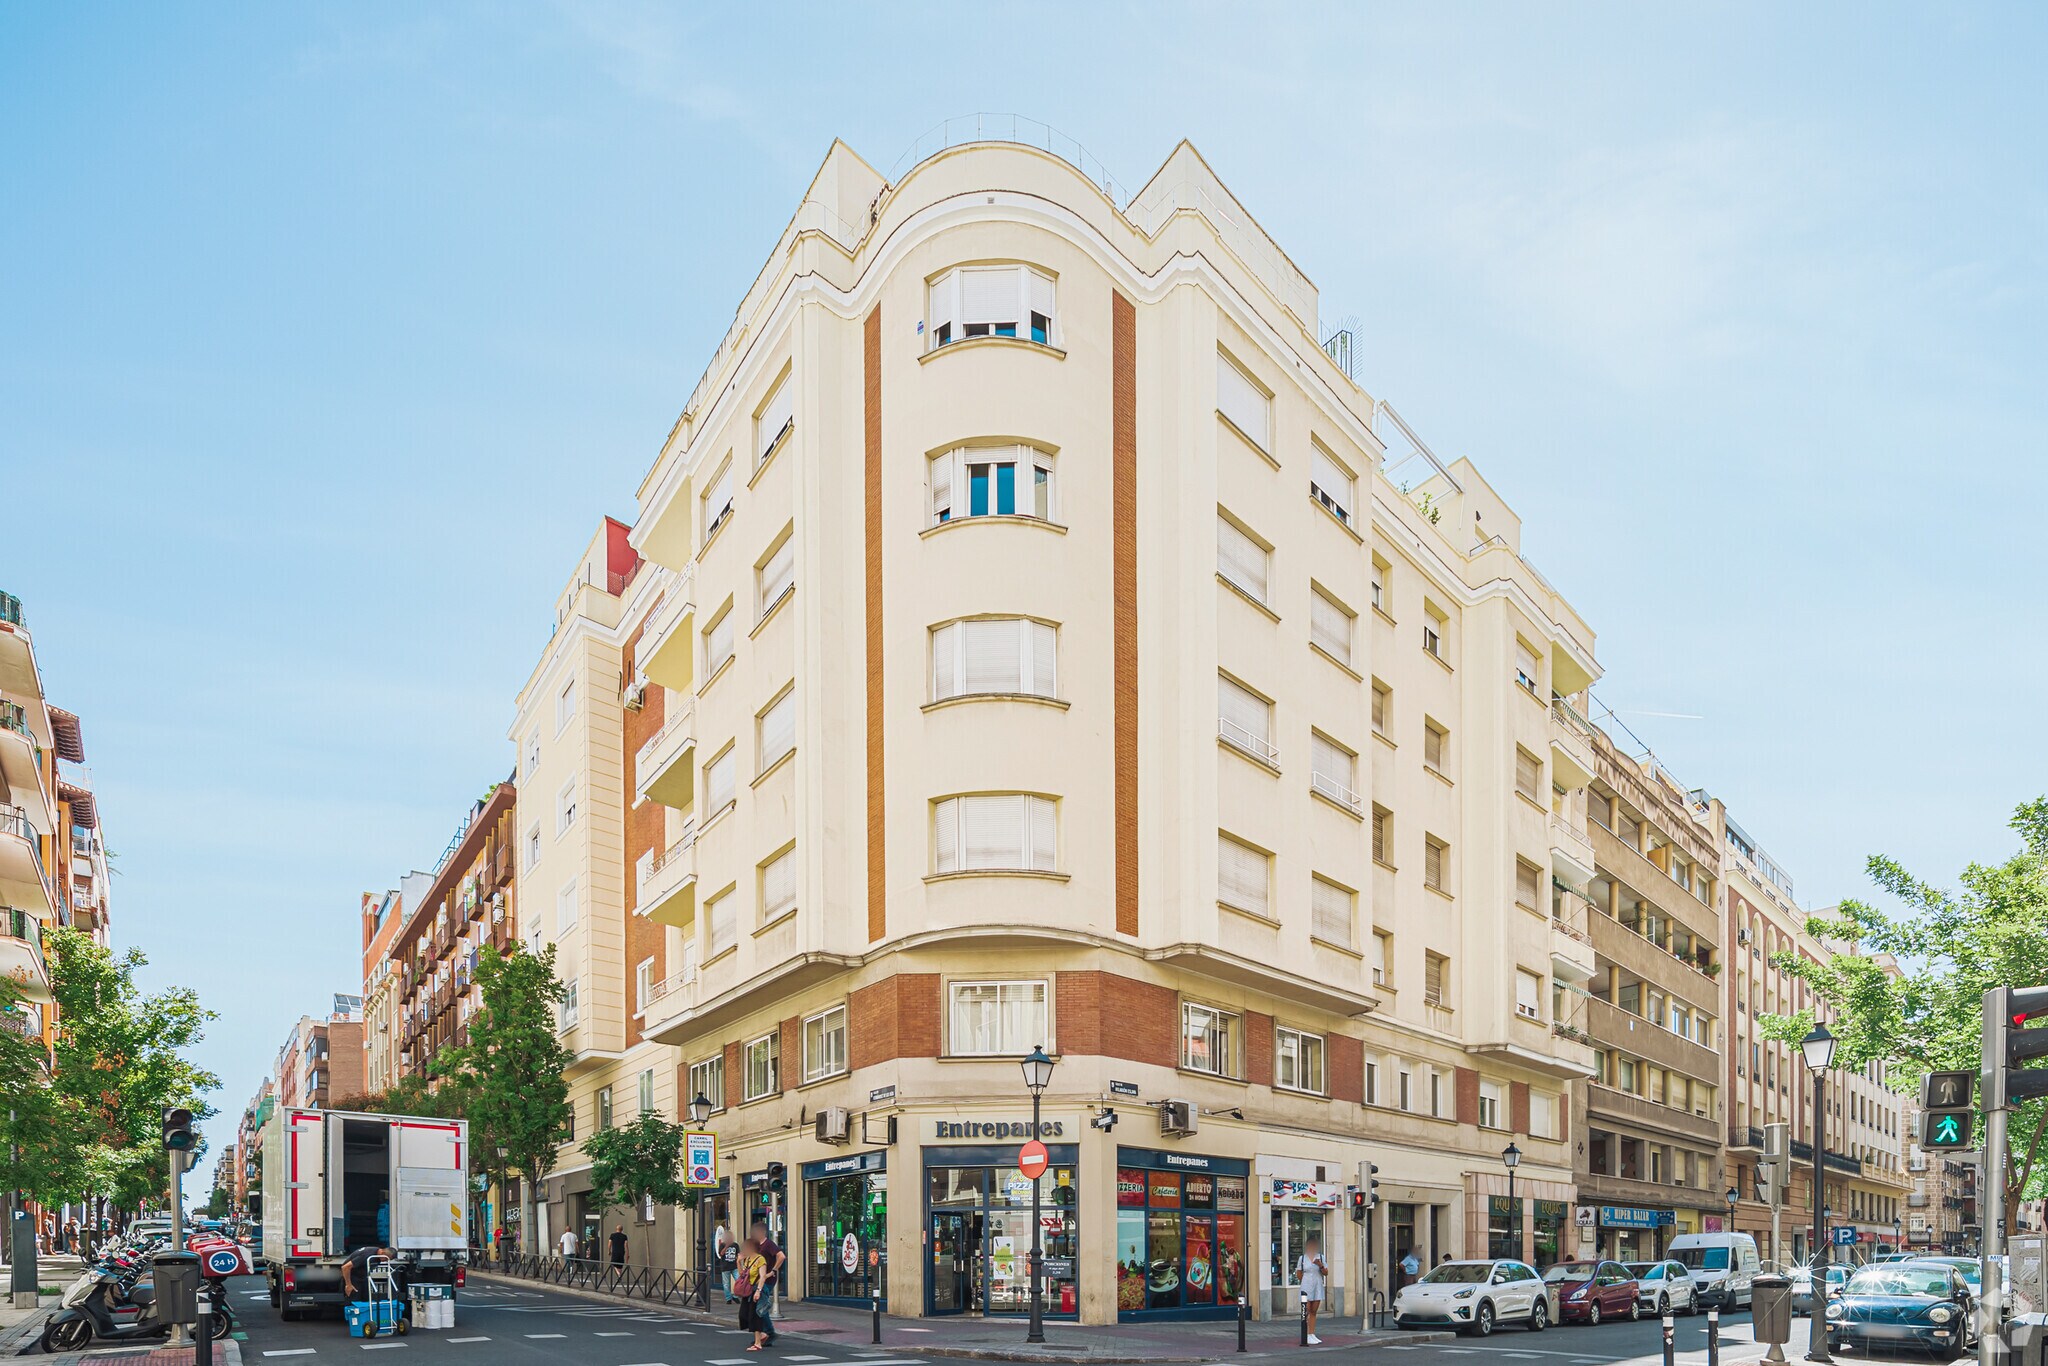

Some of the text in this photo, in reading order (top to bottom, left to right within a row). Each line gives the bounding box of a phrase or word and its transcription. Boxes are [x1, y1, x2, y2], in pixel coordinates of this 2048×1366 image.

[935, 1120, 1064, 1139] Entrepanes
[825, 1160, 856, 1171] Entrepanes
[1167, 1154, 1209, 1167] Entrepanes
[1185, 1182, 1212, 1194] ABIERTO
[1494, 1197, 1519, 1213] EQUS
[1541, 1201, 1562, 1216] EQUUS
[14, 1211, 25, 1220] P
[1614, 1208, 1631, 1220] HIPER
[1633, 1210, 1650, 1221] BAZAR
[1838, 1229, 1853, 1243] P
[213, 1259, 226, 1267] 24
